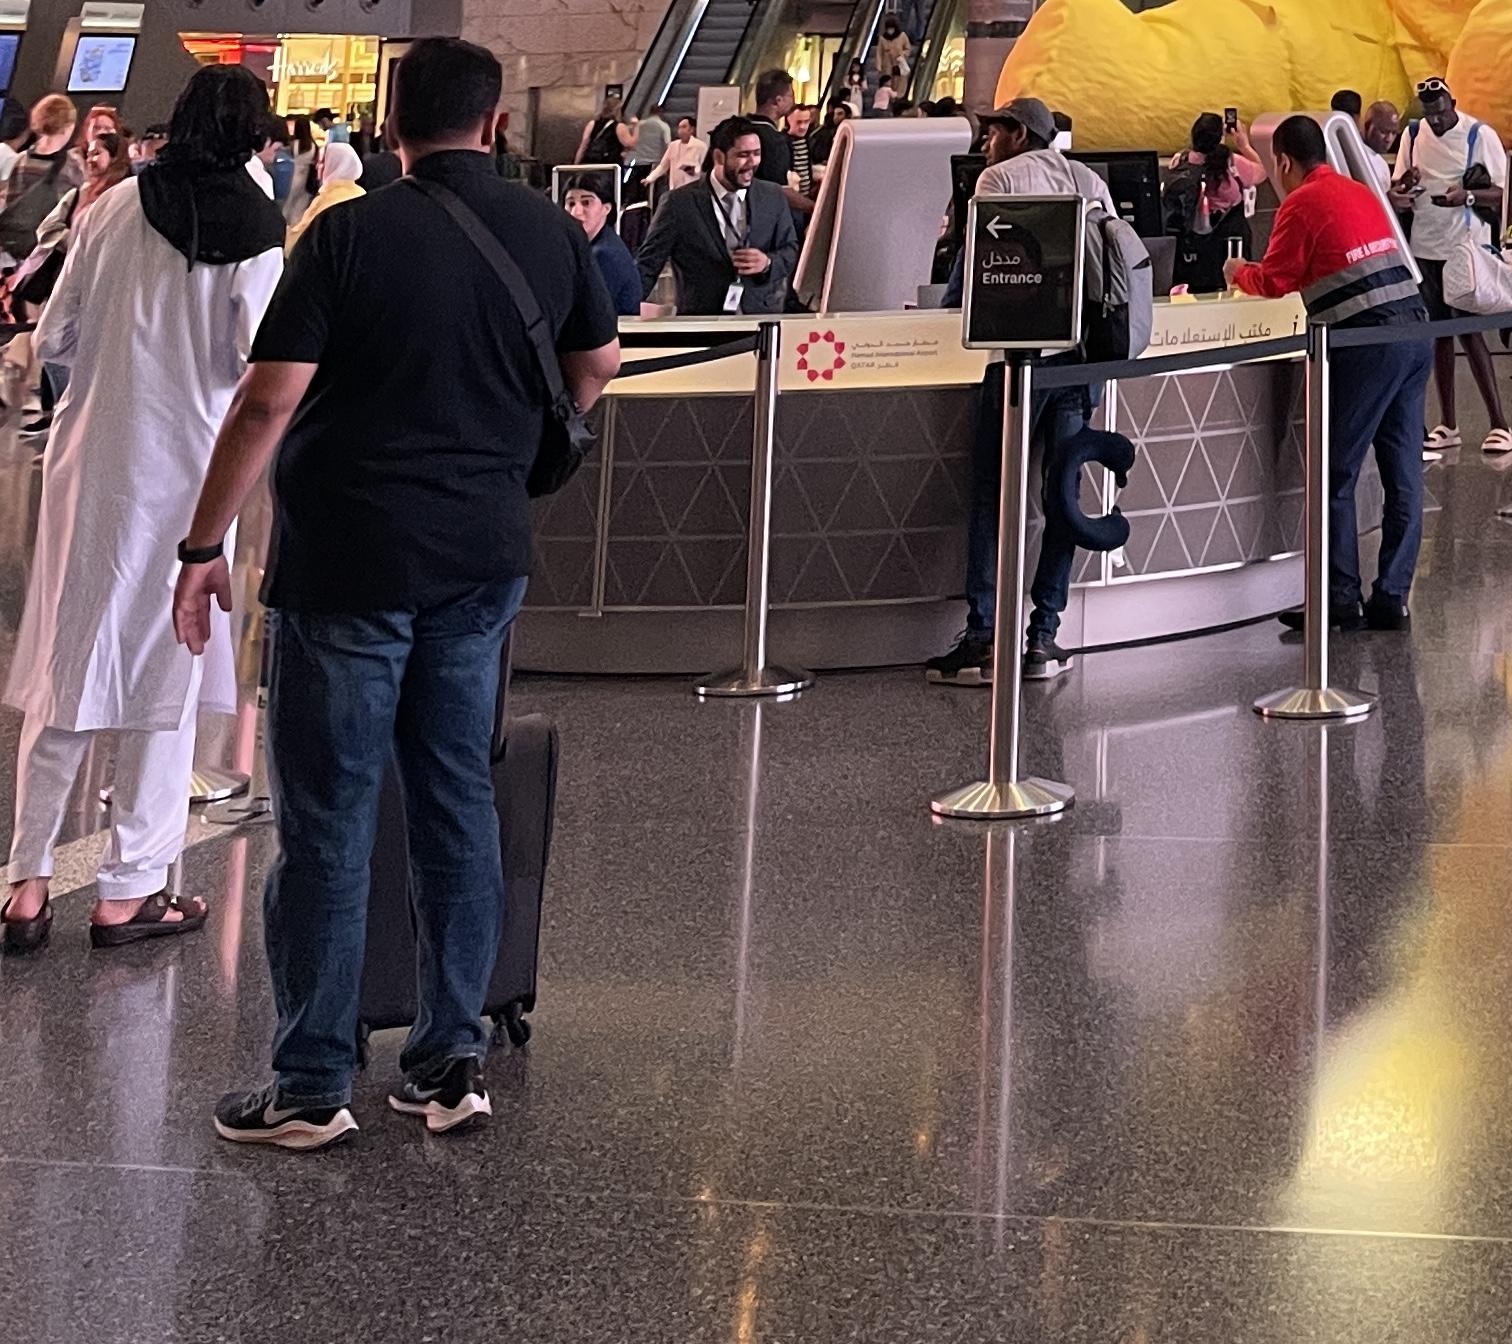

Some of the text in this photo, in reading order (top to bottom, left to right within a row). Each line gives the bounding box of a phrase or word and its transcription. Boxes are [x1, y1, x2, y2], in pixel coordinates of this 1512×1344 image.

[982, 251, 1021, 269] مدخل
[982, 272, 1043, 285] Entrance
[1239, 322, 1272, 340] مكتب
